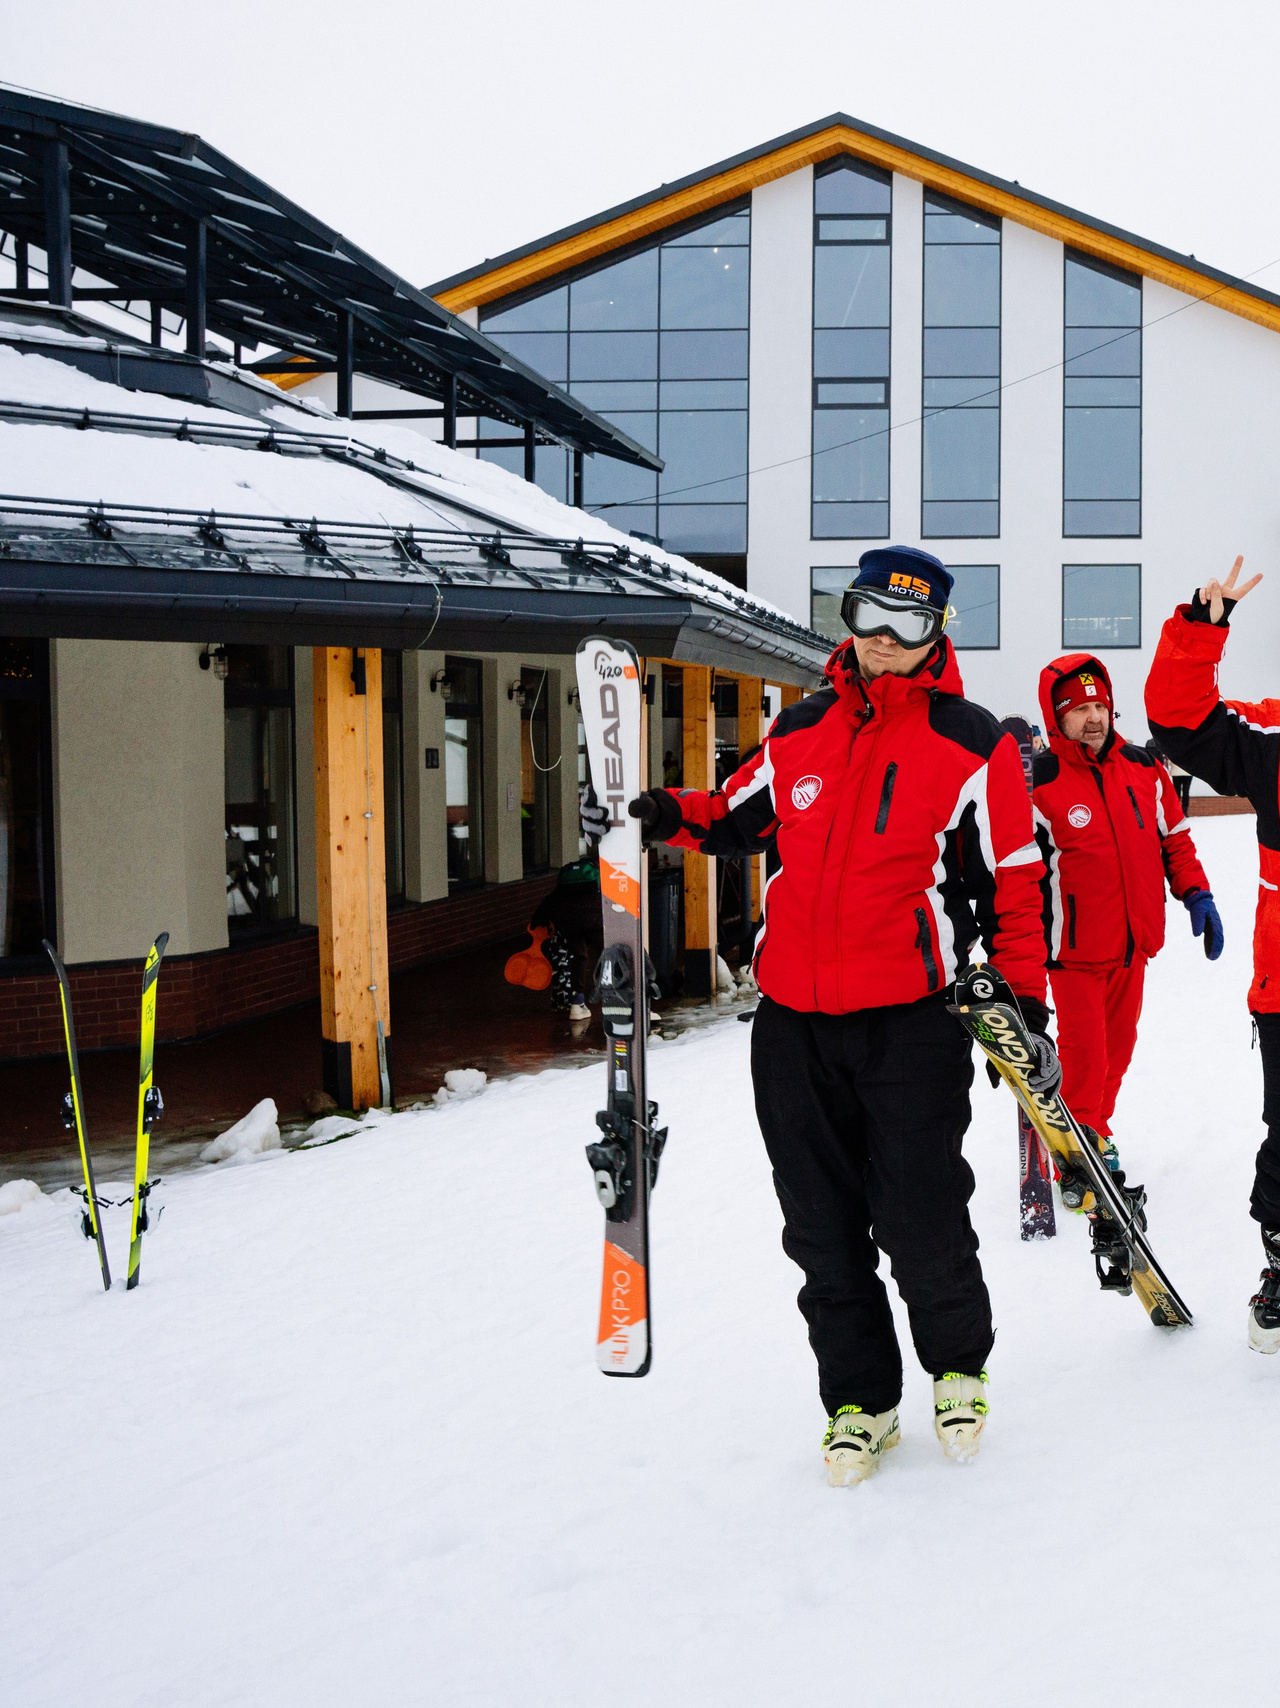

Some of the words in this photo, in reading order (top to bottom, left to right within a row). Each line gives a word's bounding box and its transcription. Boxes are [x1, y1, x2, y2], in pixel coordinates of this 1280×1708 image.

[887, 584, 929, 601] MOTOR
[889, 572, 931, 596] AS
[599, 664, 622, 680] 420
[599, 683, 625, 828] HEAD
[982, 1004, 1067, 1128] ROIGNOL
[612, 1269, 631, 1311] PRO
[611, 1314, 631, 1355] LINK
